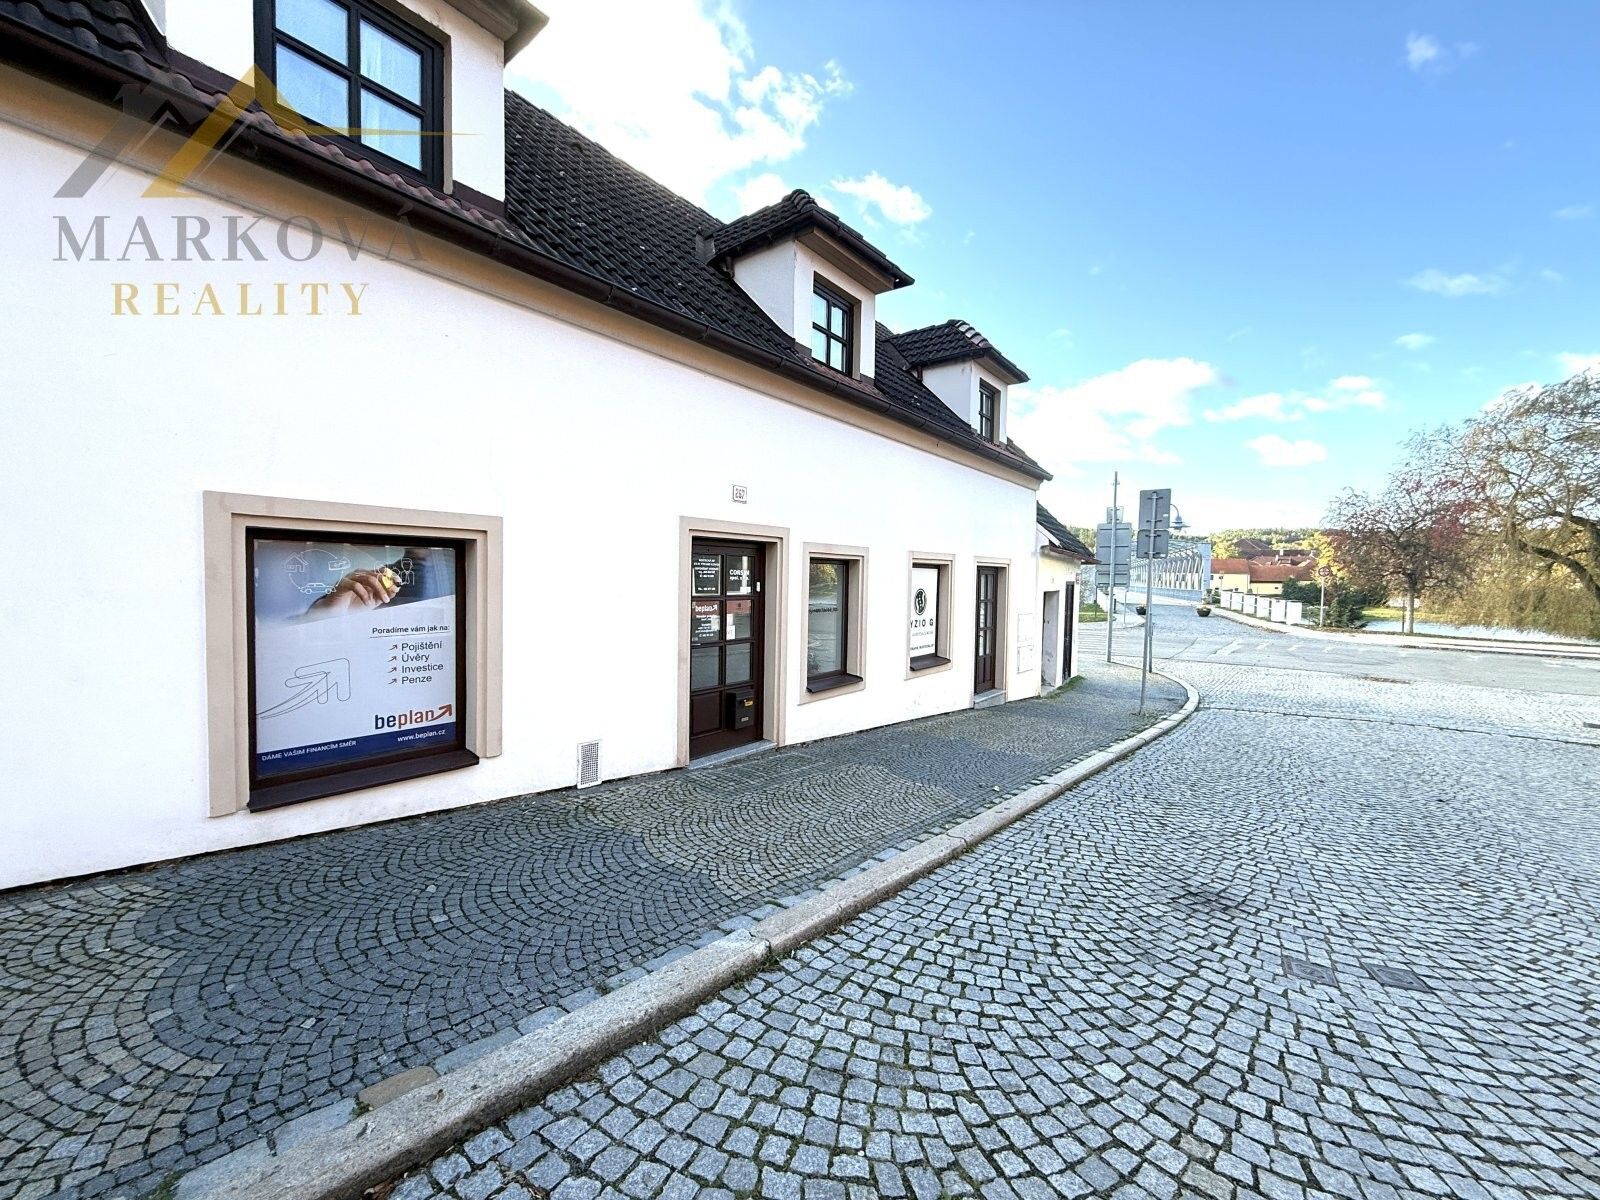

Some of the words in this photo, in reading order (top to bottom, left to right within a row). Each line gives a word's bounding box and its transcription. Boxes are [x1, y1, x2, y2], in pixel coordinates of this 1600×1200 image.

[909, 619, 926, 628] YZIO
[372, 626, 409, 634] Poradíme
[401, 641, 443, 652] Pojištění
[401, 652, 430, 662] Úvěry
[401, 663, 444, 673] Investice
[401, 675, 432, 684] Penze
[374, 709, 435, 730] beplan
[397, 729, 446, 742] www.beplan.cz
[261, 752, 282, 761] DÁME
